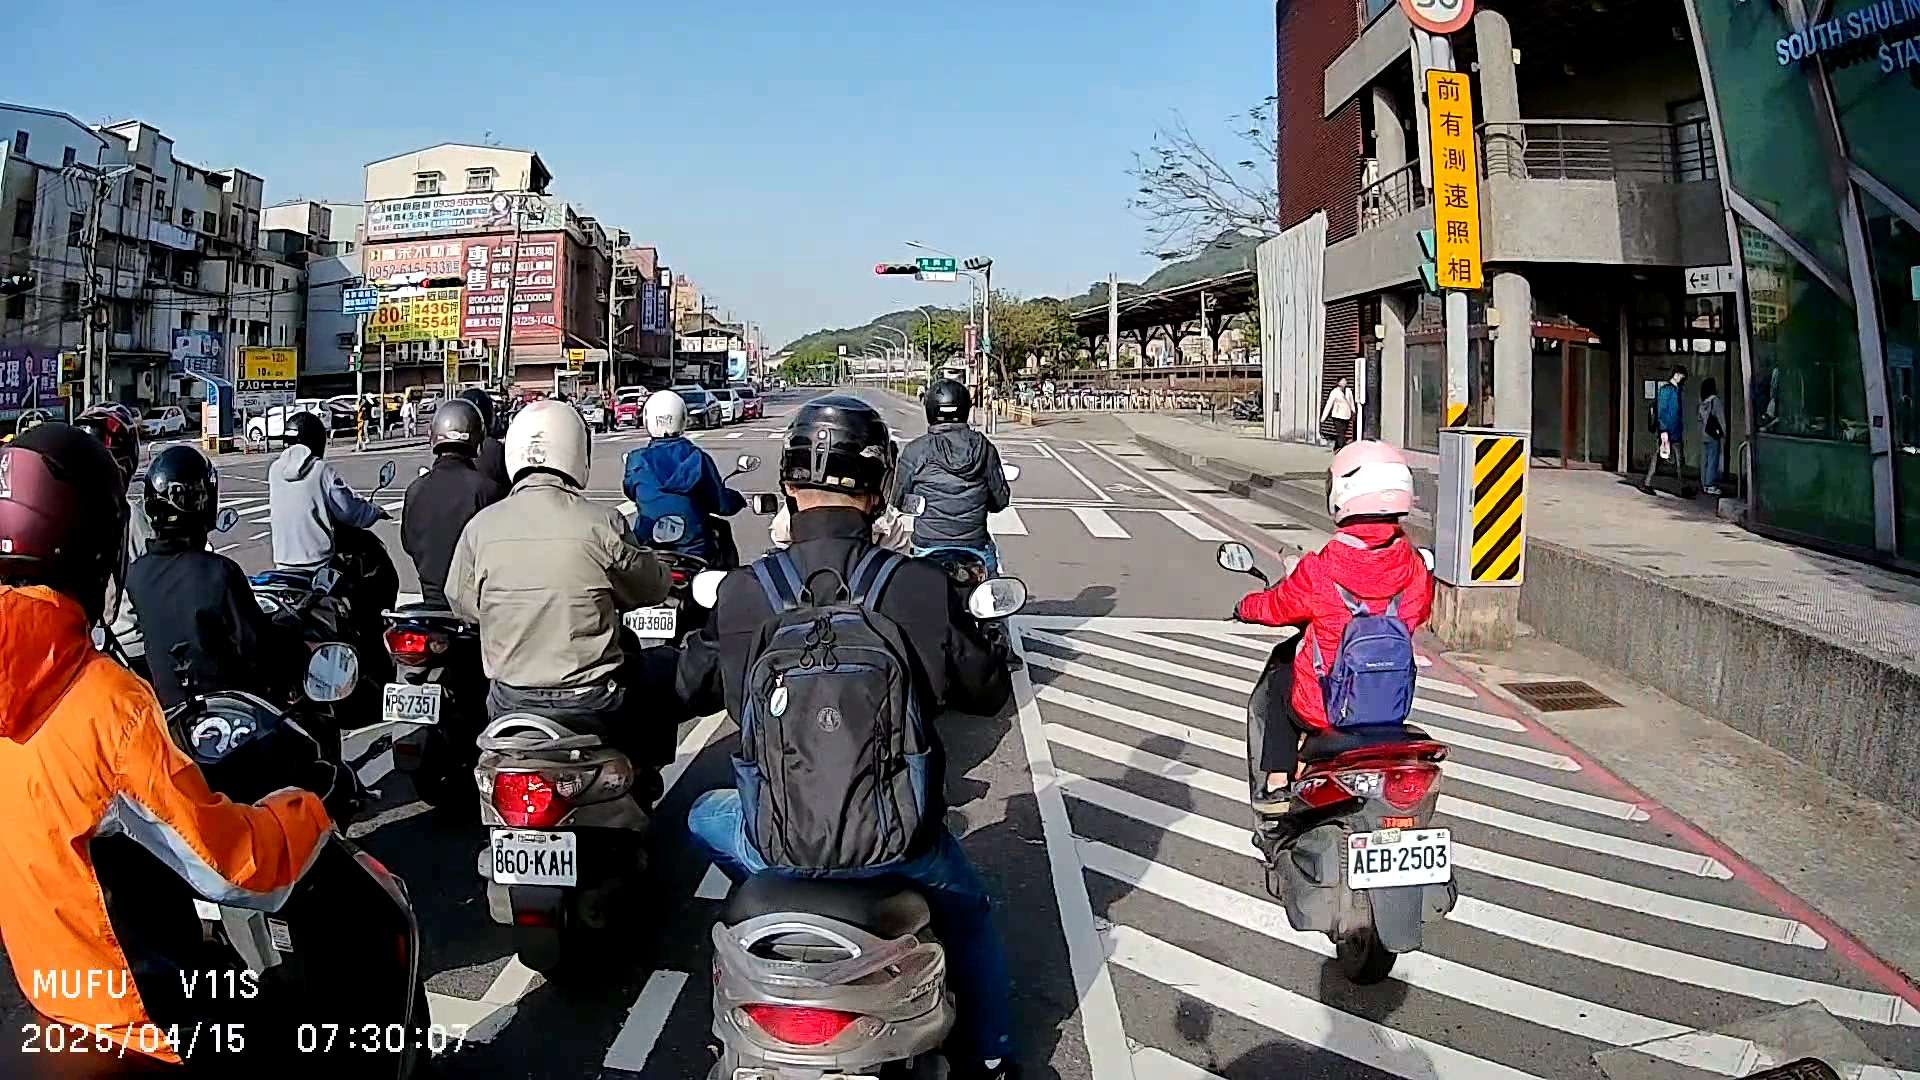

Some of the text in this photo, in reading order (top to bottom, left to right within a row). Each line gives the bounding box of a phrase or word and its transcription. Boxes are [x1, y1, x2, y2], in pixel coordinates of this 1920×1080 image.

[1776, 18, 1843, 66] SOUTH
[1437, 77, 1473, 284] 前有測速照相
[467, 246, 488, 291] 專售
[495, 849, 573, 876] 860-KAH
[1353, 844, 1447, 874] AEB-2503
